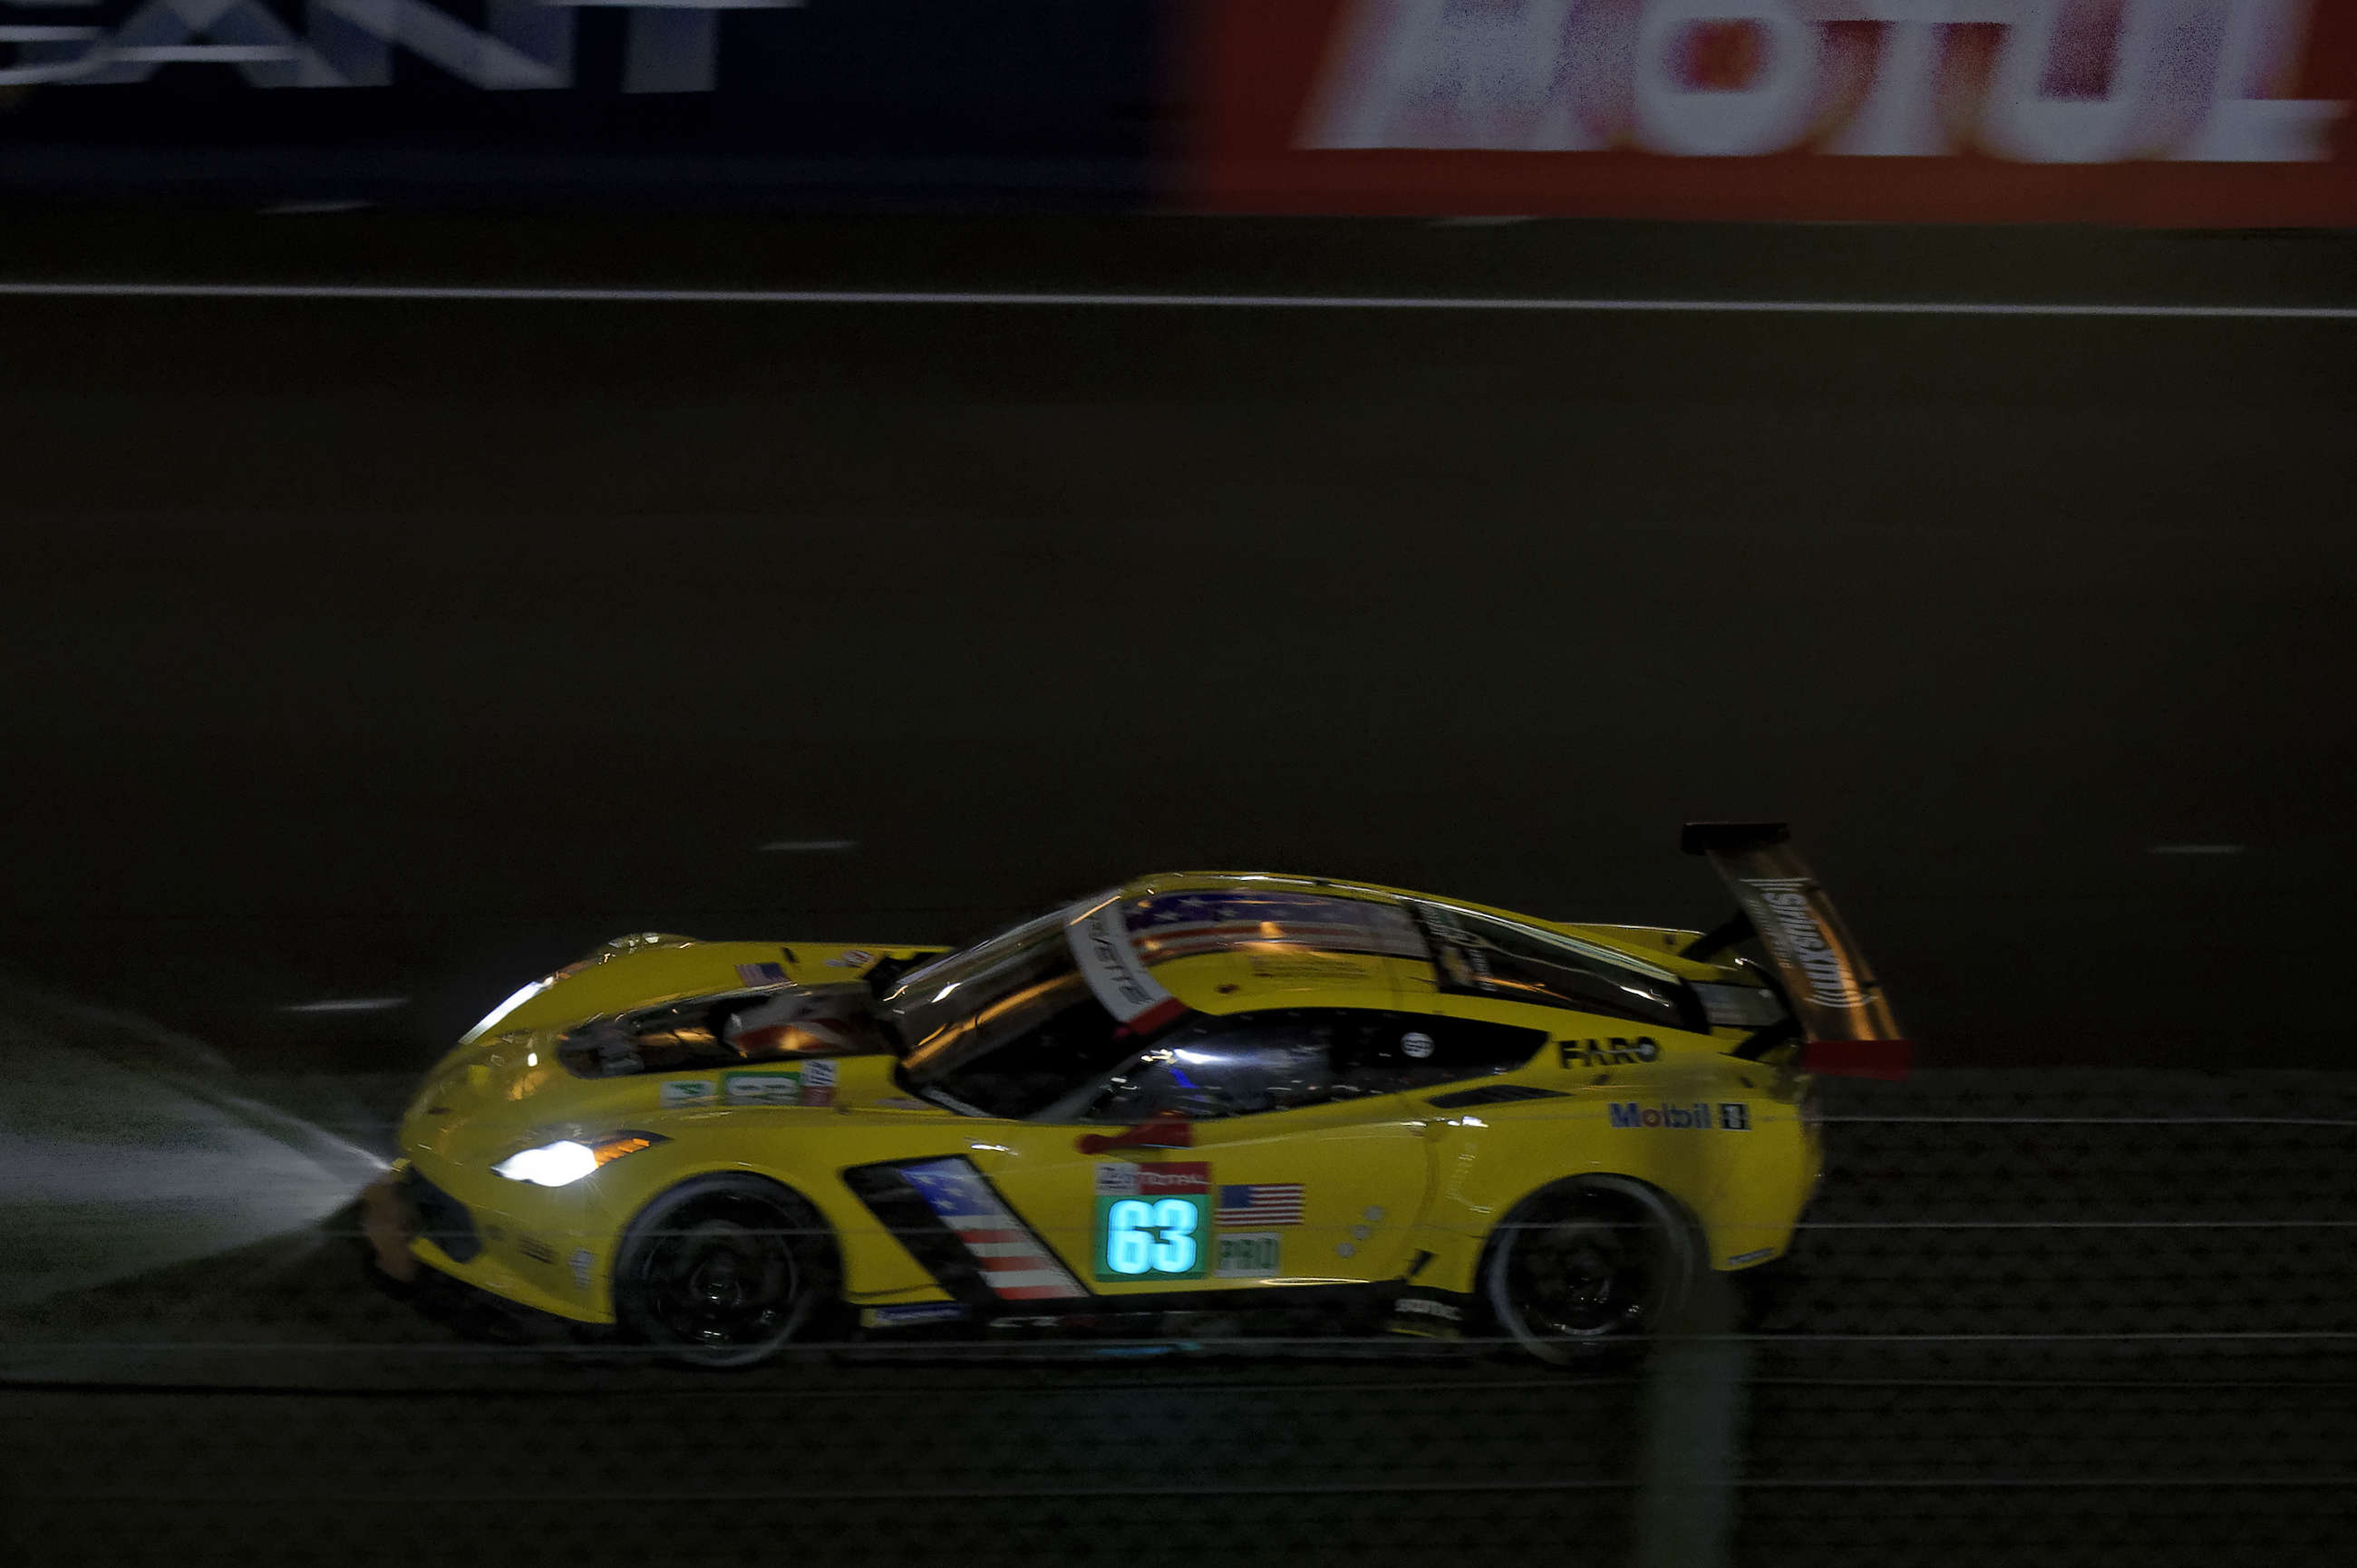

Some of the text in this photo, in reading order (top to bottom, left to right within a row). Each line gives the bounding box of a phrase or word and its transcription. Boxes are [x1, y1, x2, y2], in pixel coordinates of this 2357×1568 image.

[1559, 1036, 1659, 1069] FARO
[1609, 1102, 1712, 1128] Mobil
[1106, 1198, 1198, 1274] 63
